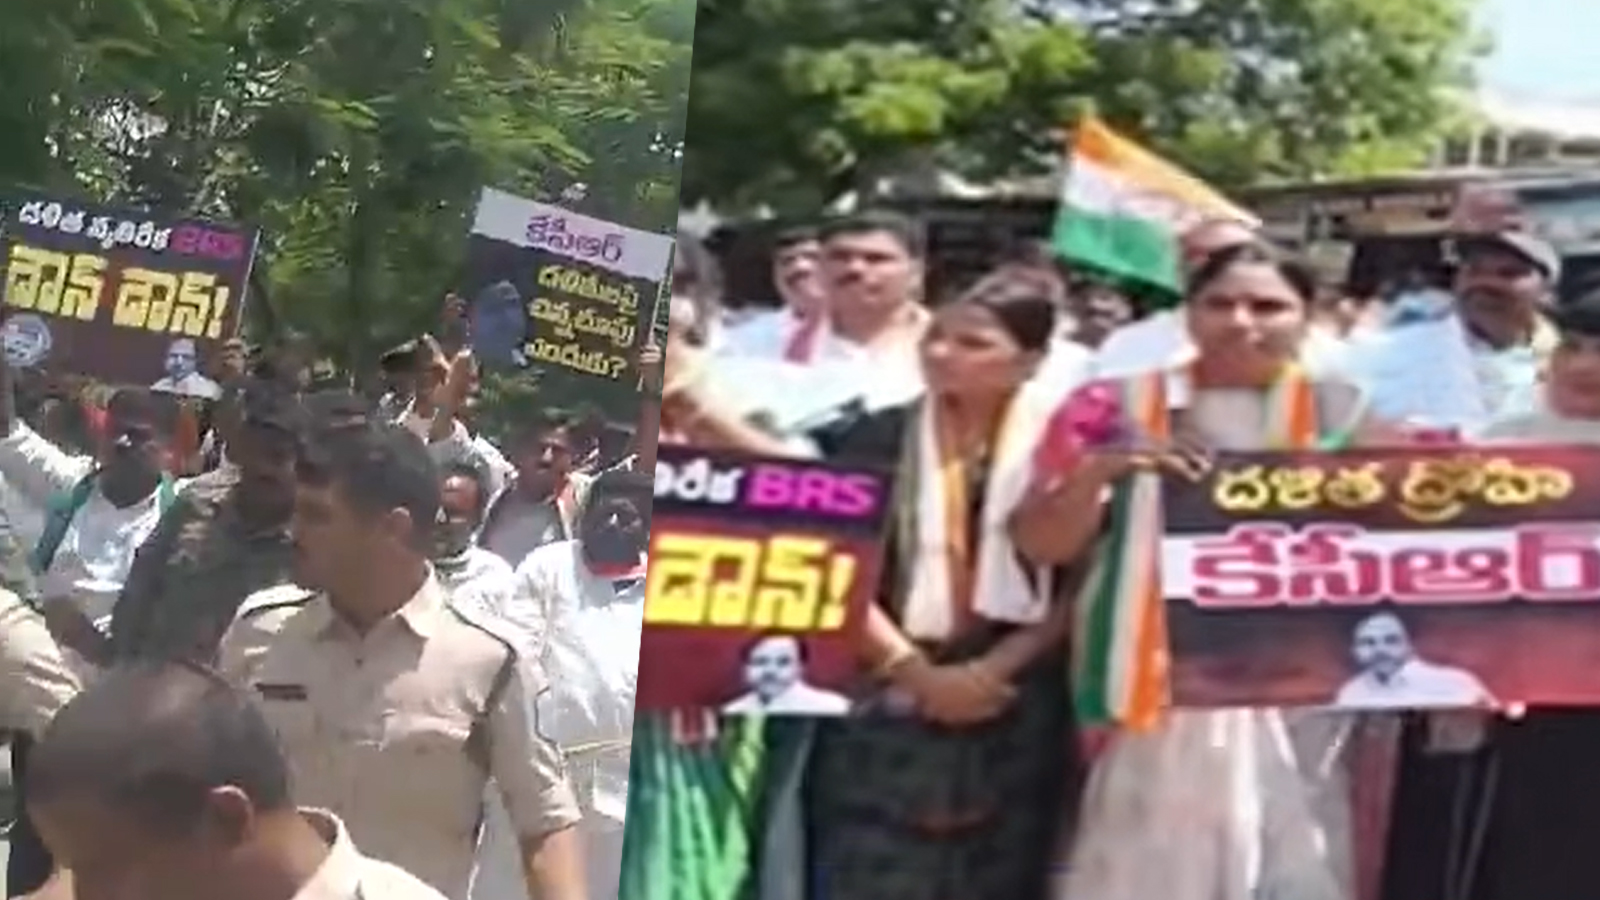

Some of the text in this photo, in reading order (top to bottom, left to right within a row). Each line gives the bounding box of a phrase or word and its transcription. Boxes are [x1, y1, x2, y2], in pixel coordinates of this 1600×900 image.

[526, 214, 625, 263] కేసీఆర్
[3, 244, 230, 340] డౌన్ డౌన్!
[745, 463, 877, 517] BRS
[643, 533, 856, 630] డౌన్!
